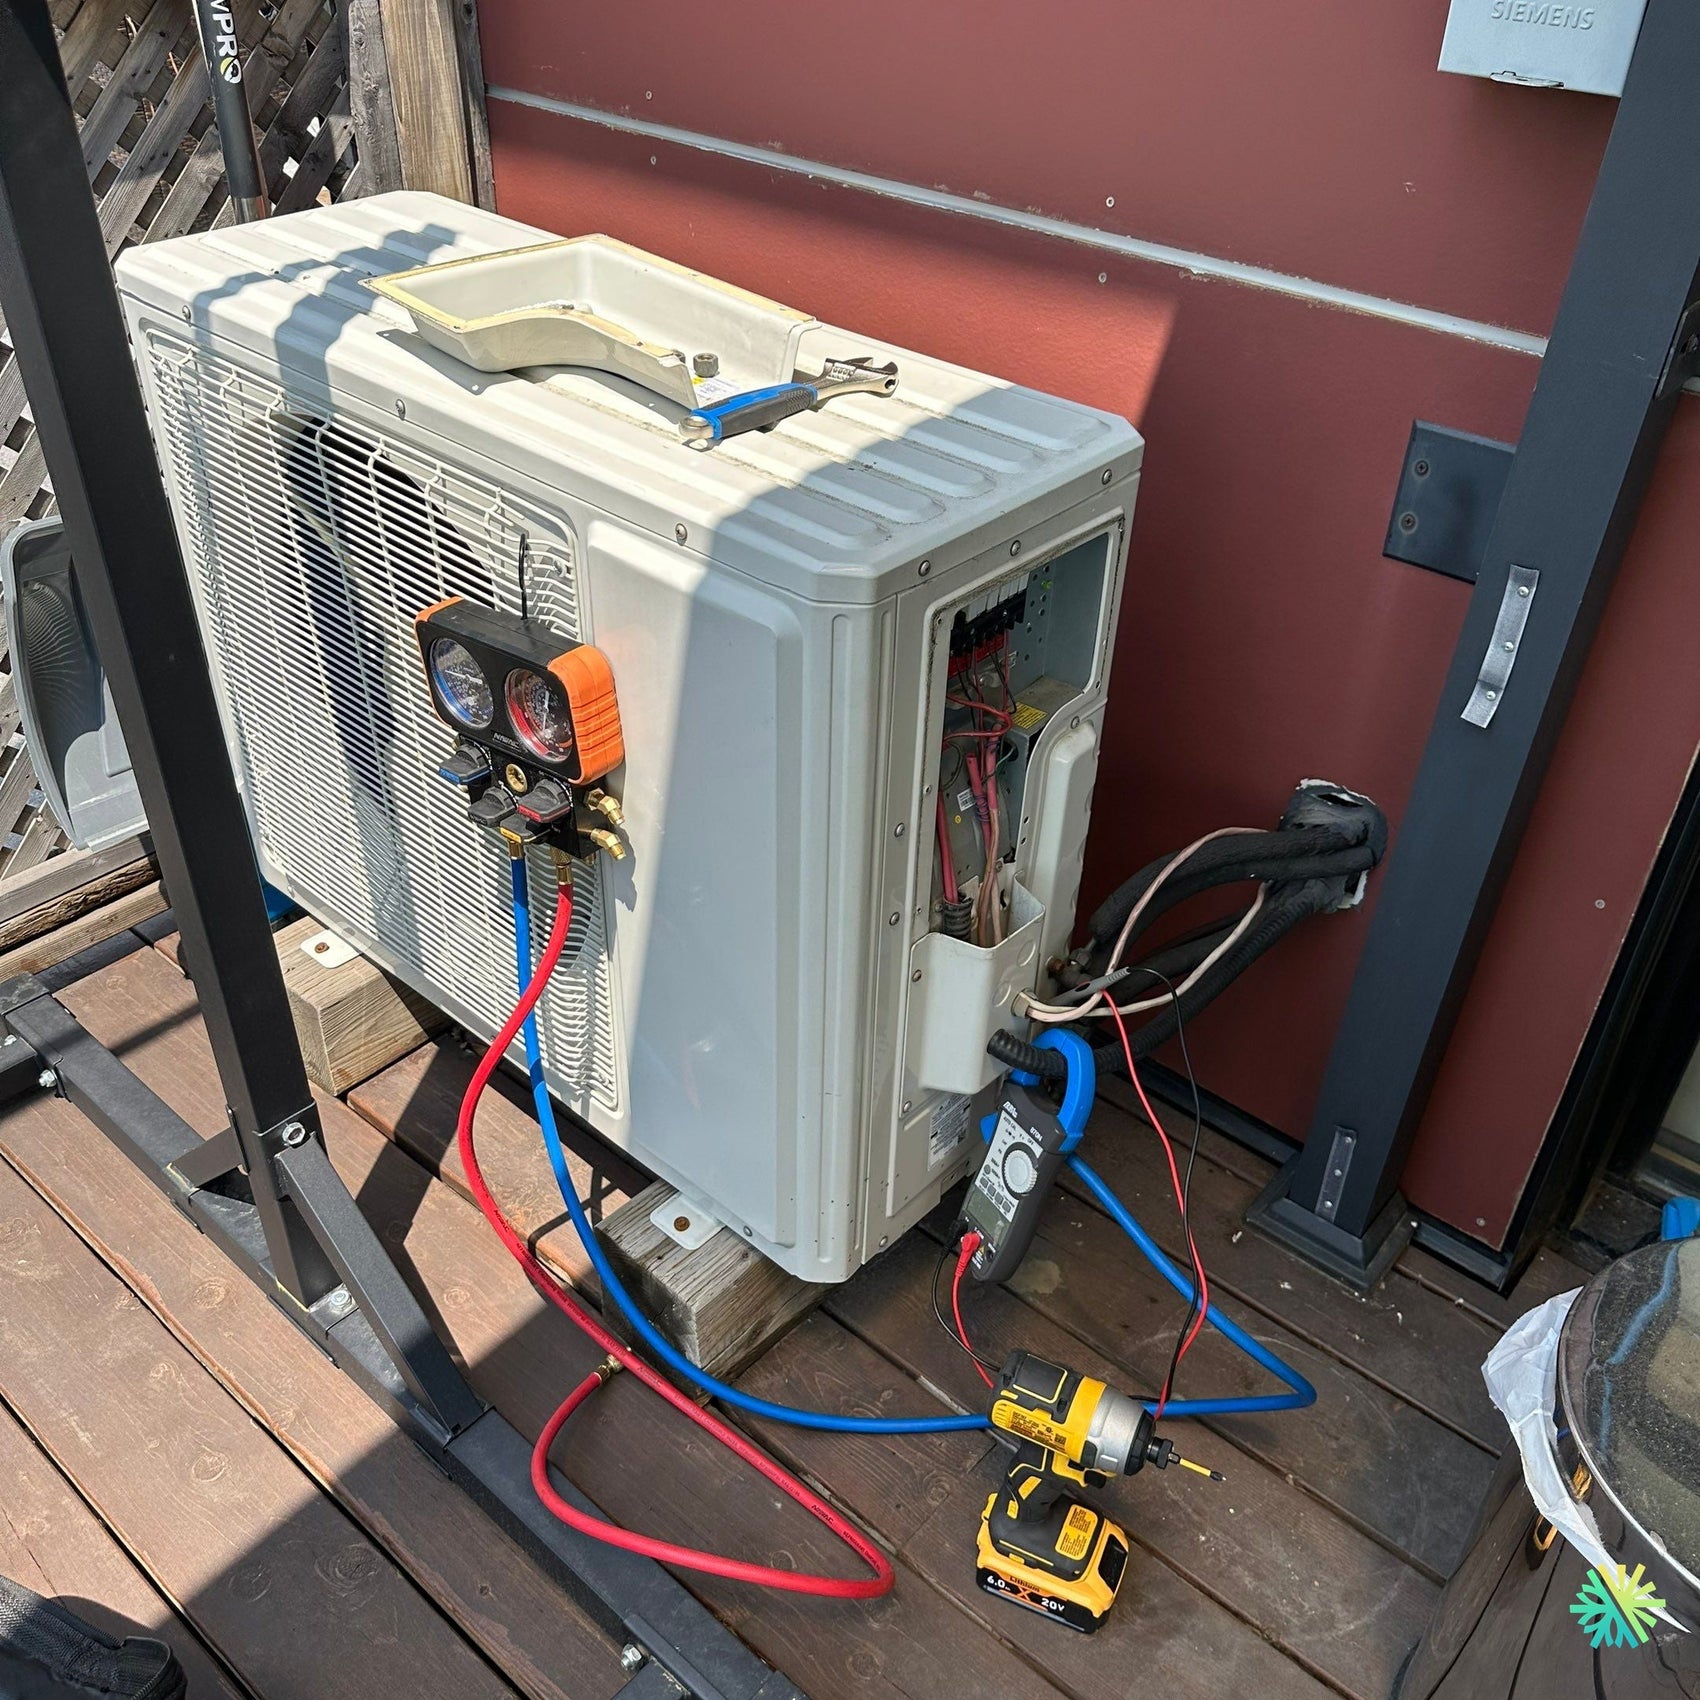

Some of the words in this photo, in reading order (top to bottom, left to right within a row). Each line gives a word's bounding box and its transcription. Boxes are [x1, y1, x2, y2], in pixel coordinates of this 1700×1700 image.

[1490, 0, 1596, 30] SIEMENS
[987, 1575, 1006, 1589] 6.0
[1010, 1575, 1040, 1593] Lithium
[1041, 1597, 1065, 1612] 20V
